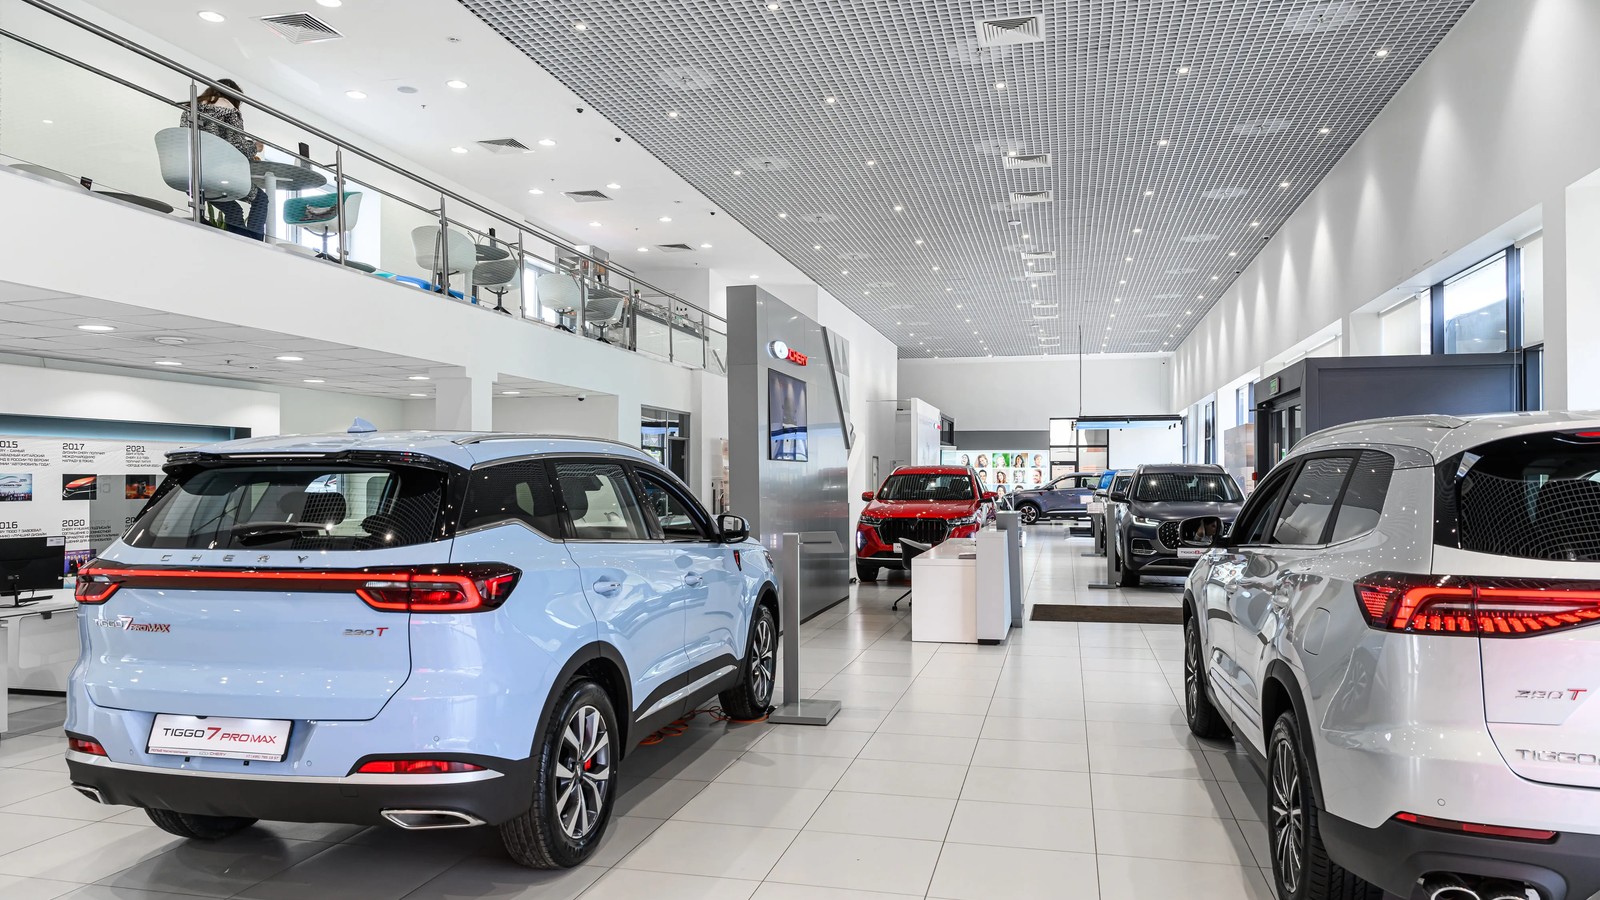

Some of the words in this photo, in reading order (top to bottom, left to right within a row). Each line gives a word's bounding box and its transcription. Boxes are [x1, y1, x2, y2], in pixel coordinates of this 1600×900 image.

[0, 440, 18, 448] 015
[62, 443, 85, 451] 2017
[0, 521, 18, 529] 016
[62, 519, 85, 527] 2020
[161, 554, 309, 563] CHERY
[163, 728, 205, 738] TIGGO
[207, 727, 221, 740] 7
